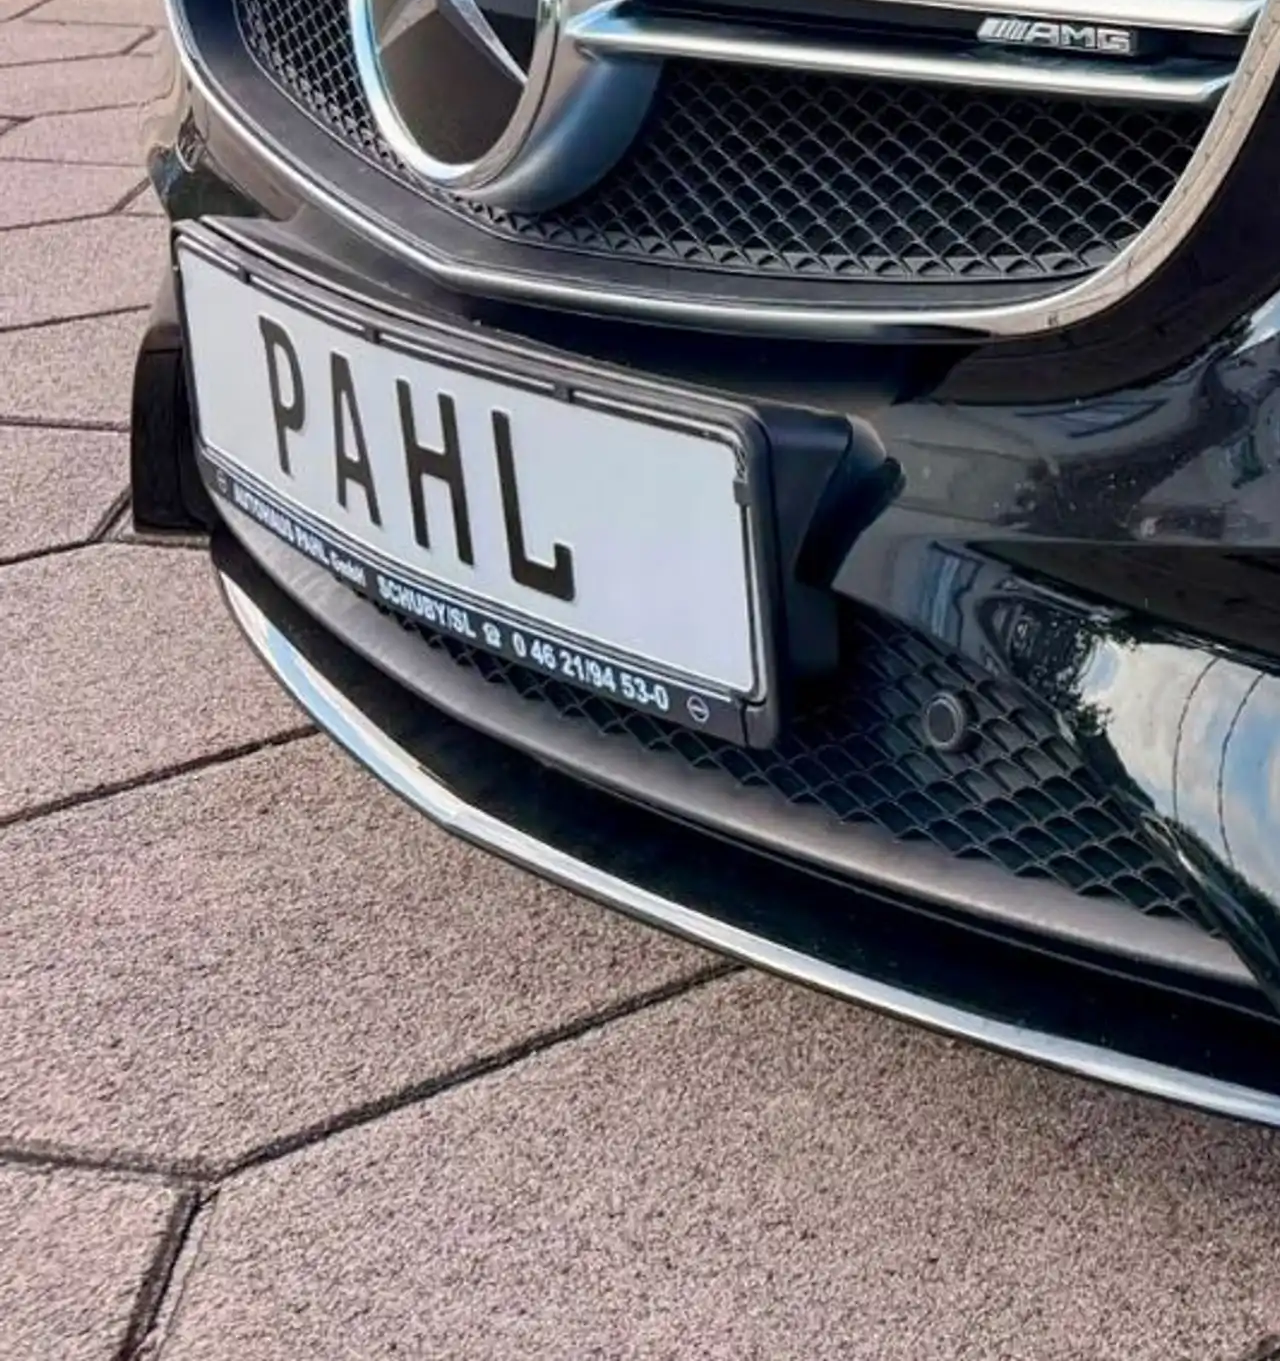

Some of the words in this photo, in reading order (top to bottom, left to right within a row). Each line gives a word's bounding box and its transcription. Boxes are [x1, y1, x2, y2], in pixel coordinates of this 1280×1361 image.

[1020, 20, 1132, 54] AMG
[258, 315, 576, 603] PAHL
[512, 632, 527, 658] 0
[530, 639, 556, 670] 46
[559, 649, 616, 693] 21/94
[620, 672, 669, 712] 53-0
